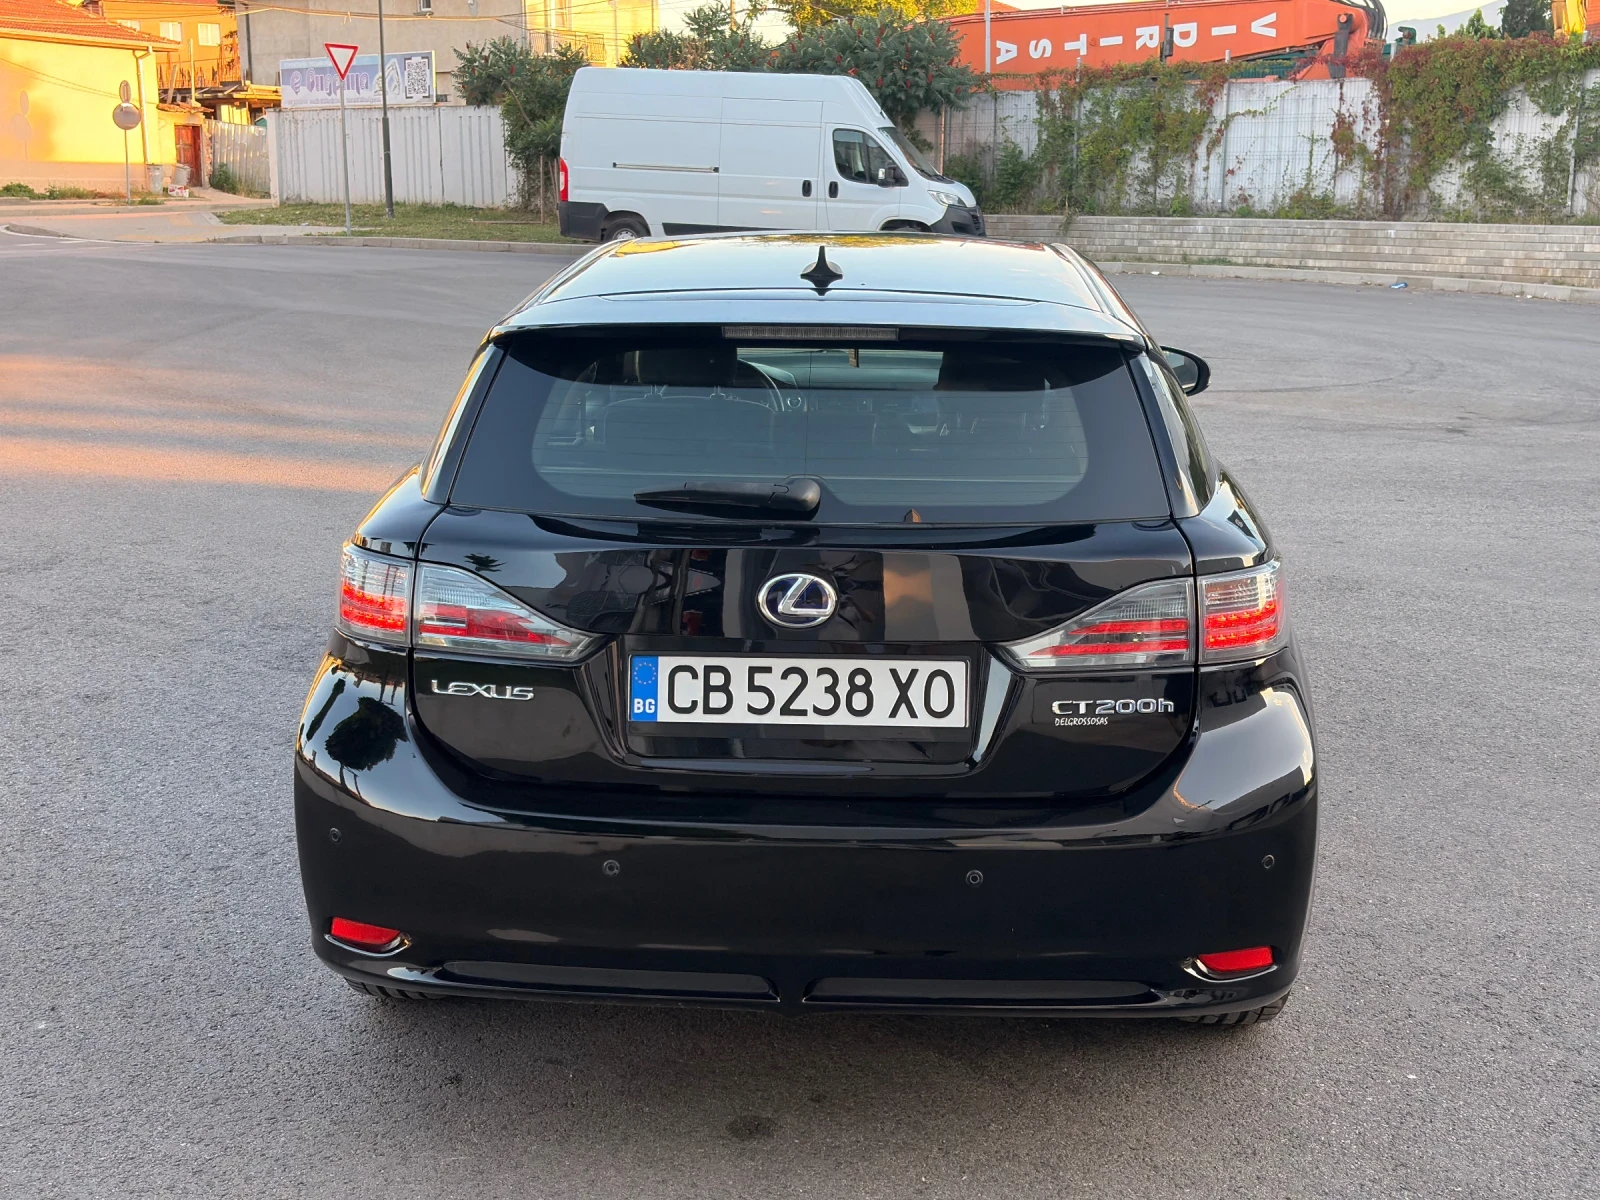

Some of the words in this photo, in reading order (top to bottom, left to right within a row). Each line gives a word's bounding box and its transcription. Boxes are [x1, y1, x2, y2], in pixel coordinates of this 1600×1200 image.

[431, 679, 534, 701] LEXUS
[667, 664, 734, 715] CB
[746, 665, 874, 718] 5238
[888, 668, 955, 719] XO
[633, 698, 655, 715] BG
[1054, 717, 1109, 726] DELGROSSOSAS
